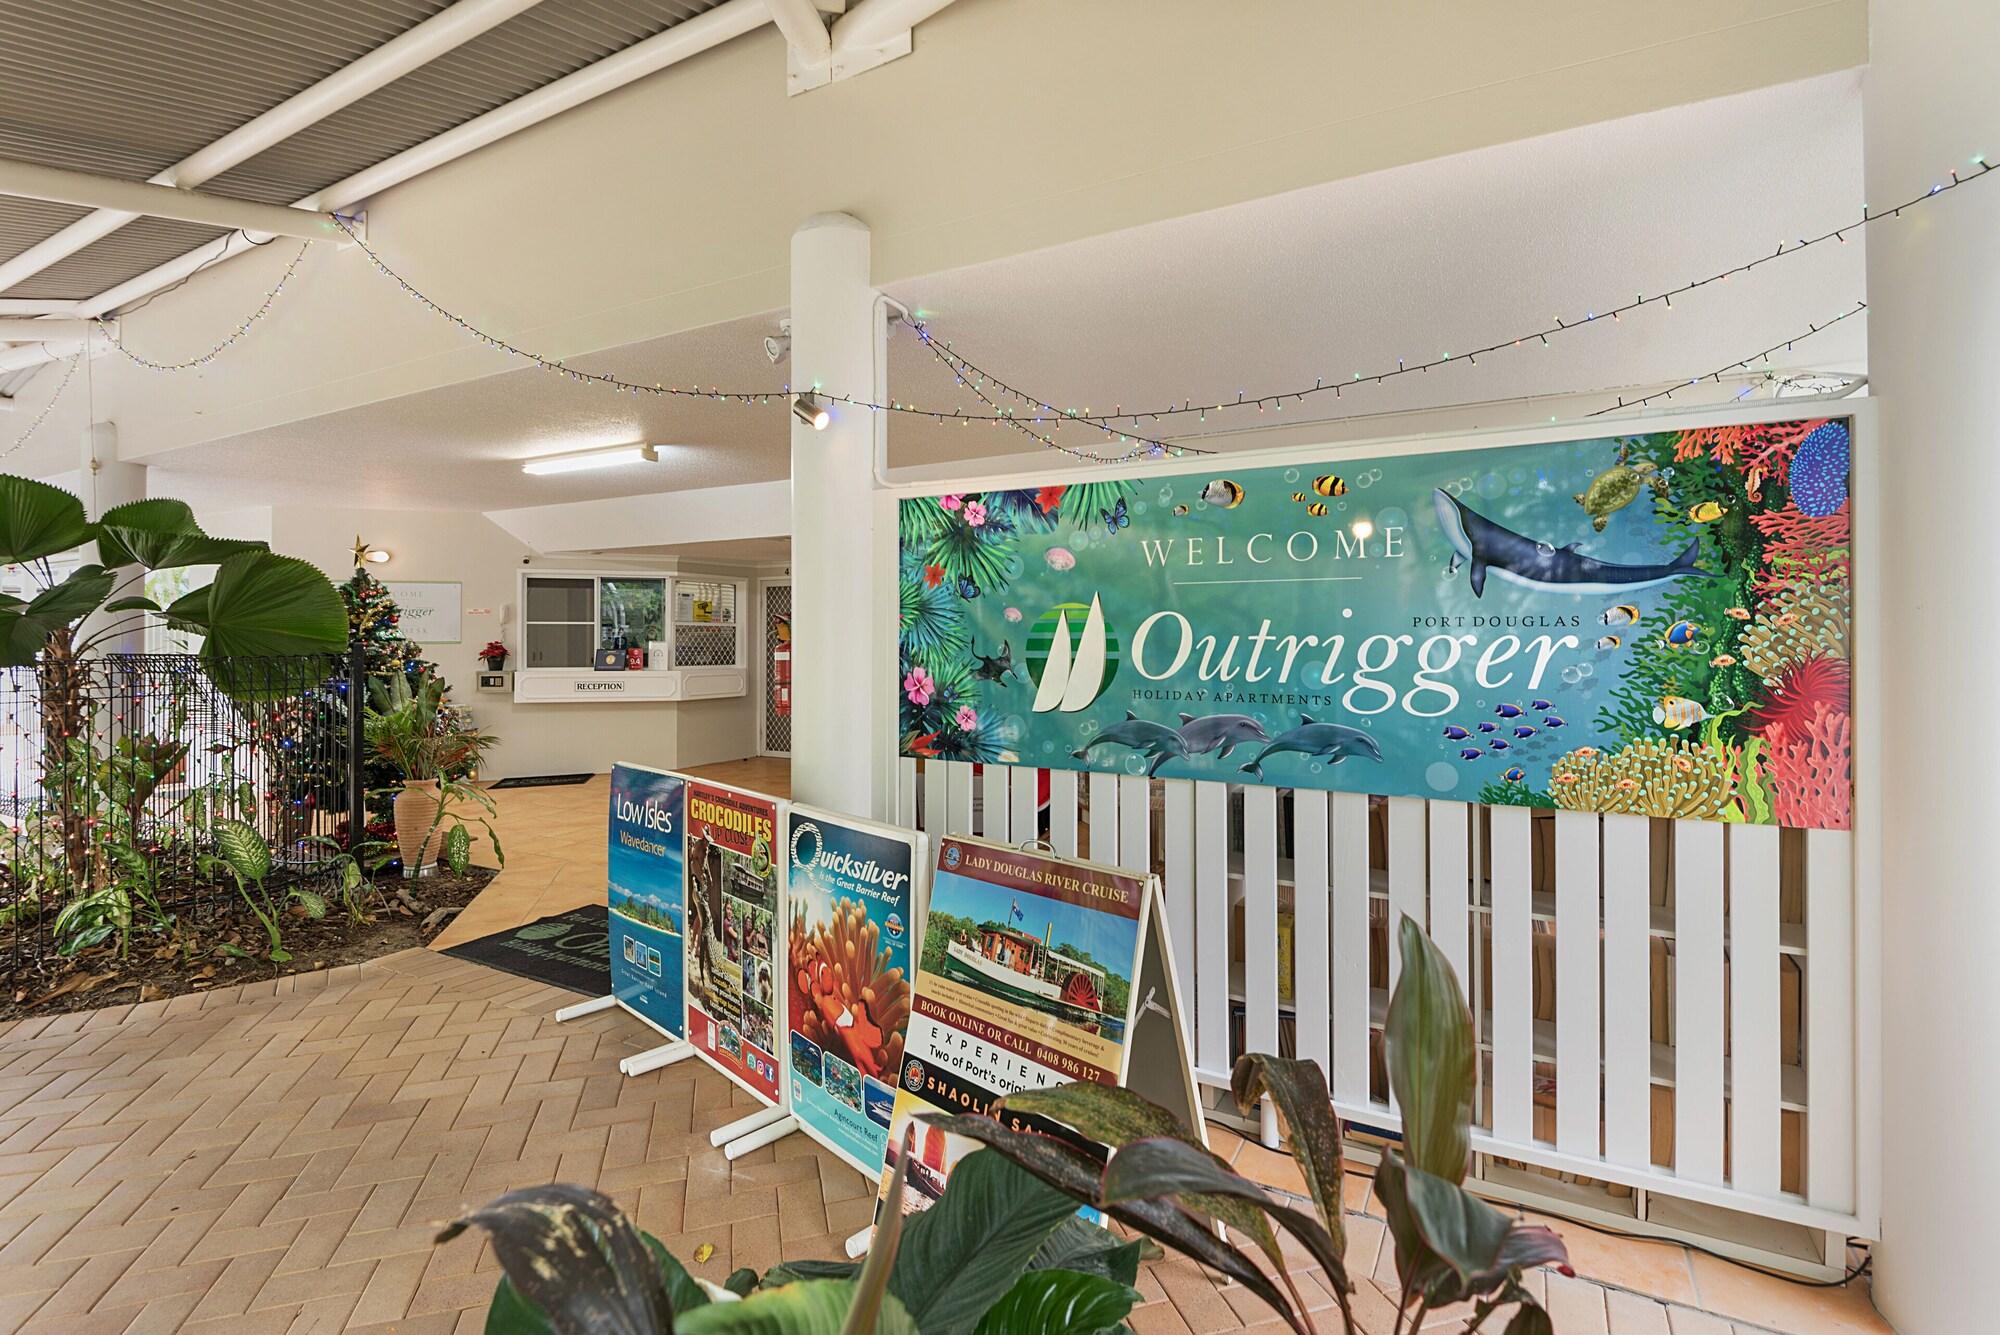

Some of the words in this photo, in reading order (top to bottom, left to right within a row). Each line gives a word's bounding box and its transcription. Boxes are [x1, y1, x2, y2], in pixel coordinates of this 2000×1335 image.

[1140, 525, 1406, 570] WELCOME
[1412, 616, 1467, 628] PORT
[1472, 614, 1581, 628] DOUGLAS
[1130, 607, 1579, 717] Outrigger
[1131, 688, 1207, 702] HOLIDAY
[1213, 691, 1333, 707] APARTMENTS
[617, 792, 644, 825] Low
[645, 800, 672, 833] Isles
[690, 798, 772, 842] CROCODILES
[620, 829, 667, 857] Wavedancer
[790, 822, 908, 892] Quicksilver
[836, 877, 855, 891] Great
[855, 883, 880, 899] Barrier
[881, 891, 901, 907] Reef
[965, 854, 992, 870] LADY
[993, 860, 1043, 883] DOUGLAS
[1044, 873, 1080, 893] RIVER
[1082, 881, 1129, 904] CRUISE
[920, 1000, 947, 1019] BOOK
[948, 1011, 985, 1035] ONLINE
[987, 1027, 1002, 1042] OR
[1004, 1034, 1031, 1055] CALL
[1036, 1047, 1059, 1065] 0408
[1061, 1057, 1079, 1074] 986
[1082, 1064, 1100, 1081] 127
[931, 1027, 1064, 1088] EXPERIEN
[929, 1044, 949, 1062] Two
[952, 1056, 964, 1069] of
[965, 1061, 996, 1085] Port's
[999, 1078, 1026, 1094] orig
[926, 1076, 1001, 1122] SHAOLIN
[834, 1107, 863, 1134] Agincourt
[864, 1127, 879, 1143] Reef
